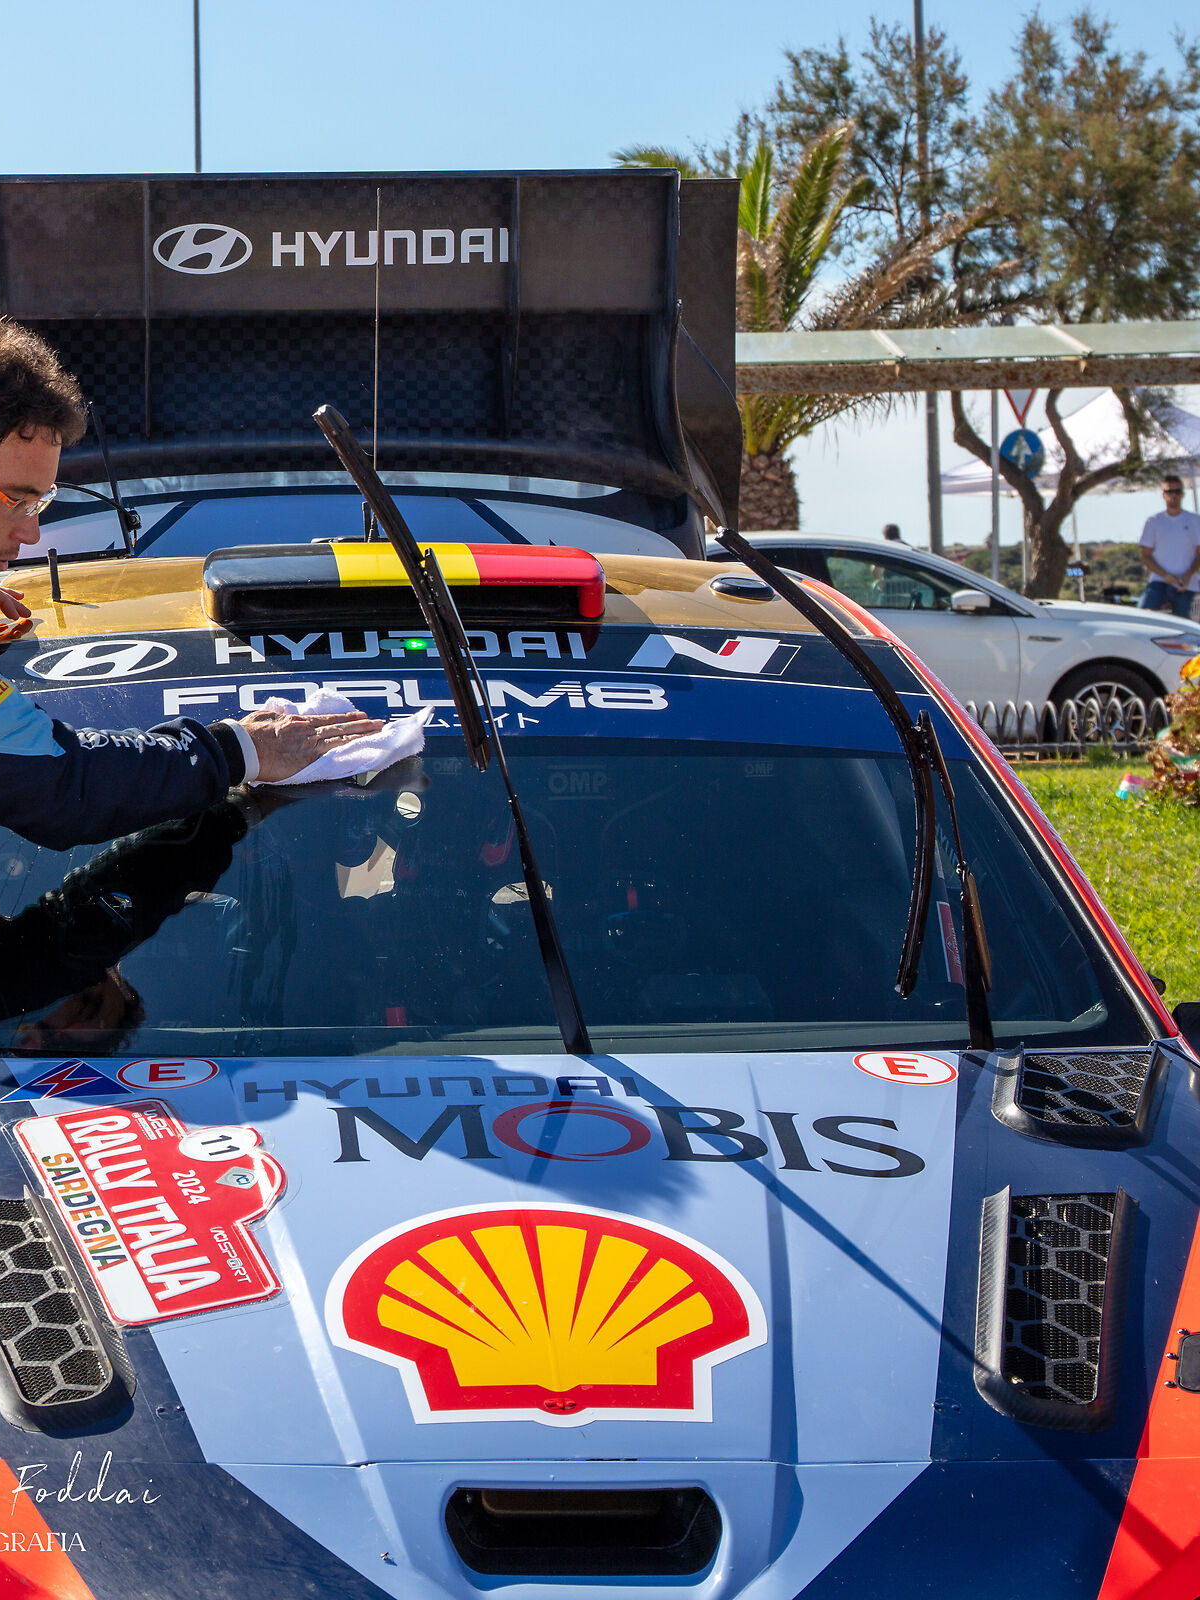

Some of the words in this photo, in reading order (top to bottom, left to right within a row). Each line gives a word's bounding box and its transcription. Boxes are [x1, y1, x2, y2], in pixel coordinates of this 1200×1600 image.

[271, 227, 509, 267] HYUNDAI
[163, 679, 669, 716] FORUM8
[243, 1075, 640, 1103] HYUNDAI
[65, 1114, 158, 1192] RALLY
[200, 1134, 241, 1156] 11
[327, 1100, 926, 1179] MOBIS
[171, 1169, 212, 1205] 2024
[41, 1152, 129, 1272] SARDEGNA
[110, 1195, 222, 1302] ITALIA
